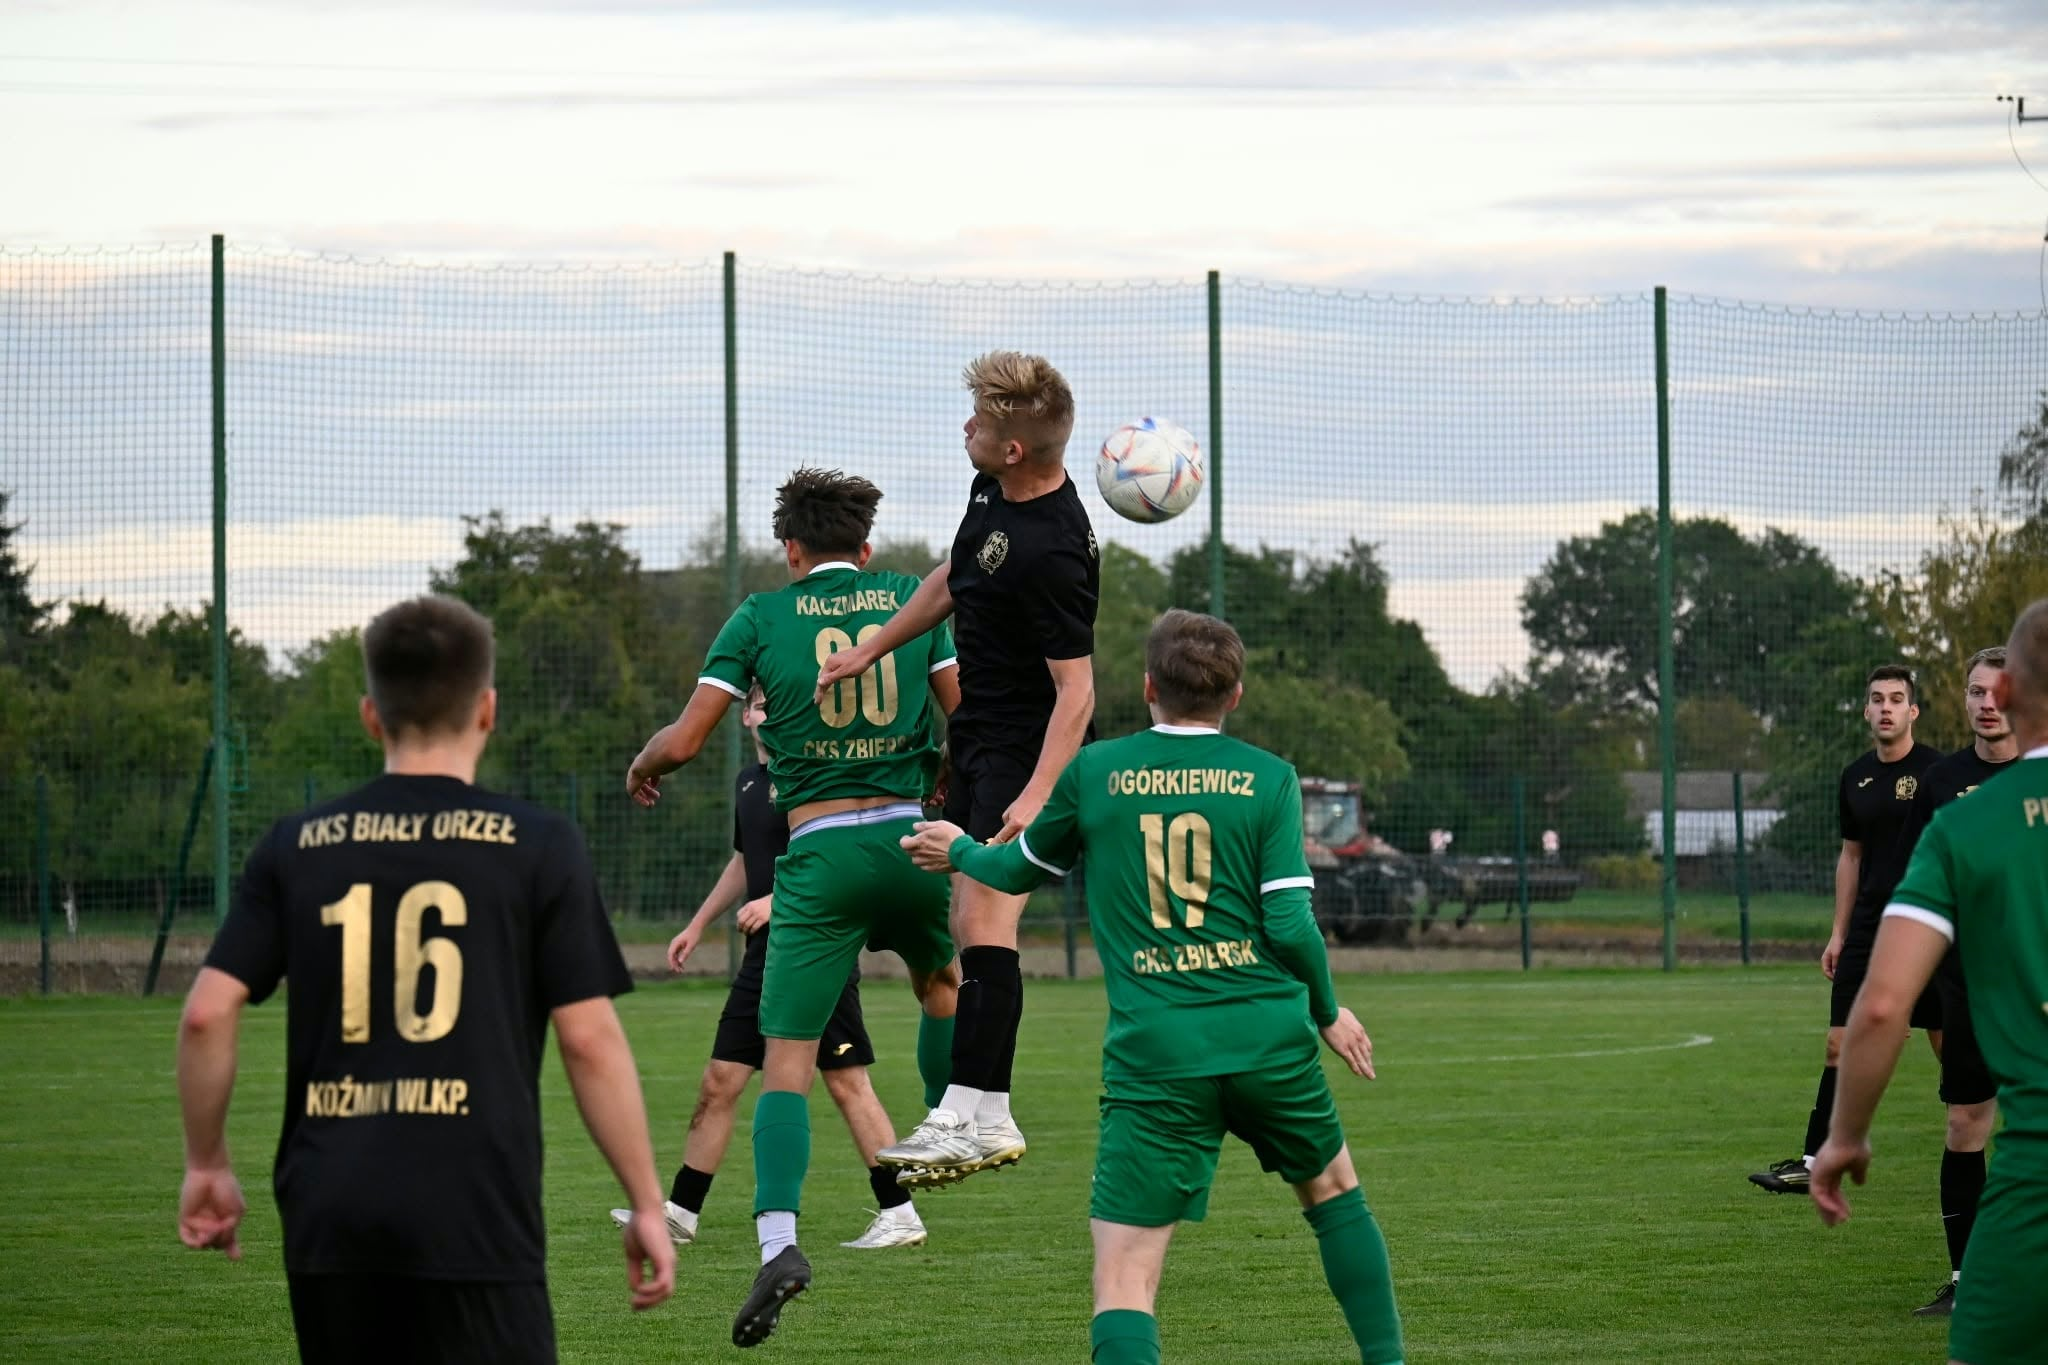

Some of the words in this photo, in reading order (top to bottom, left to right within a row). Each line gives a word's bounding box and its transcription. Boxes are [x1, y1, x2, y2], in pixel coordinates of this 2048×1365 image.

[796, 590, 901, 616] KACZMAREK
[815, 624, 899, 729] 80
[803, 740, 840, 759] CKS
[1108, 764, 1255, 796] OGÓRKIEWICZ
[299, 813, 348, 849] KKS
[352, 811, 428, 842] BIAŁY
[432, 809, 516, 845] ORZEŁ
[1140, 812, 1212, 929] 19
[321, 880, 468, 1043] 16
[1133, 947, 1172, 974] CKS
[1174, 938, 1259, 972] ZBIERSK
[396, 1078, 469, 1115] WLKP.
